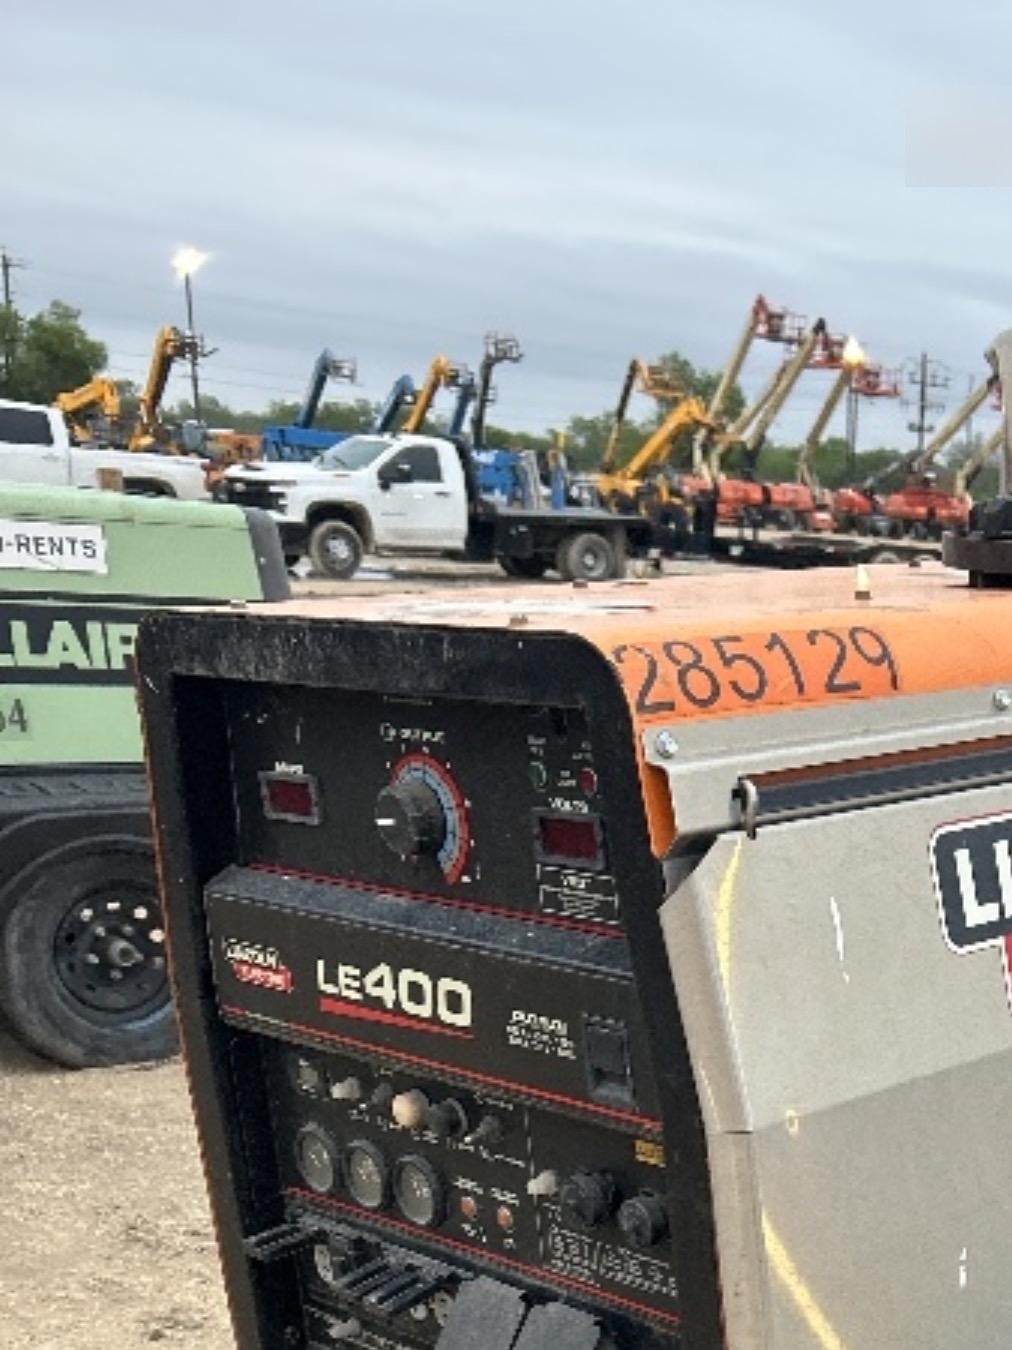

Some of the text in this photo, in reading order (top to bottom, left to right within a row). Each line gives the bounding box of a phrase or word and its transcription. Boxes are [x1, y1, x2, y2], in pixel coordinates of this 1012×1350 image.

[0, 618, 139, 671] LAIR
[611, 626, 899, 714] 285129
[316, 958, 473, 1028] LE400
